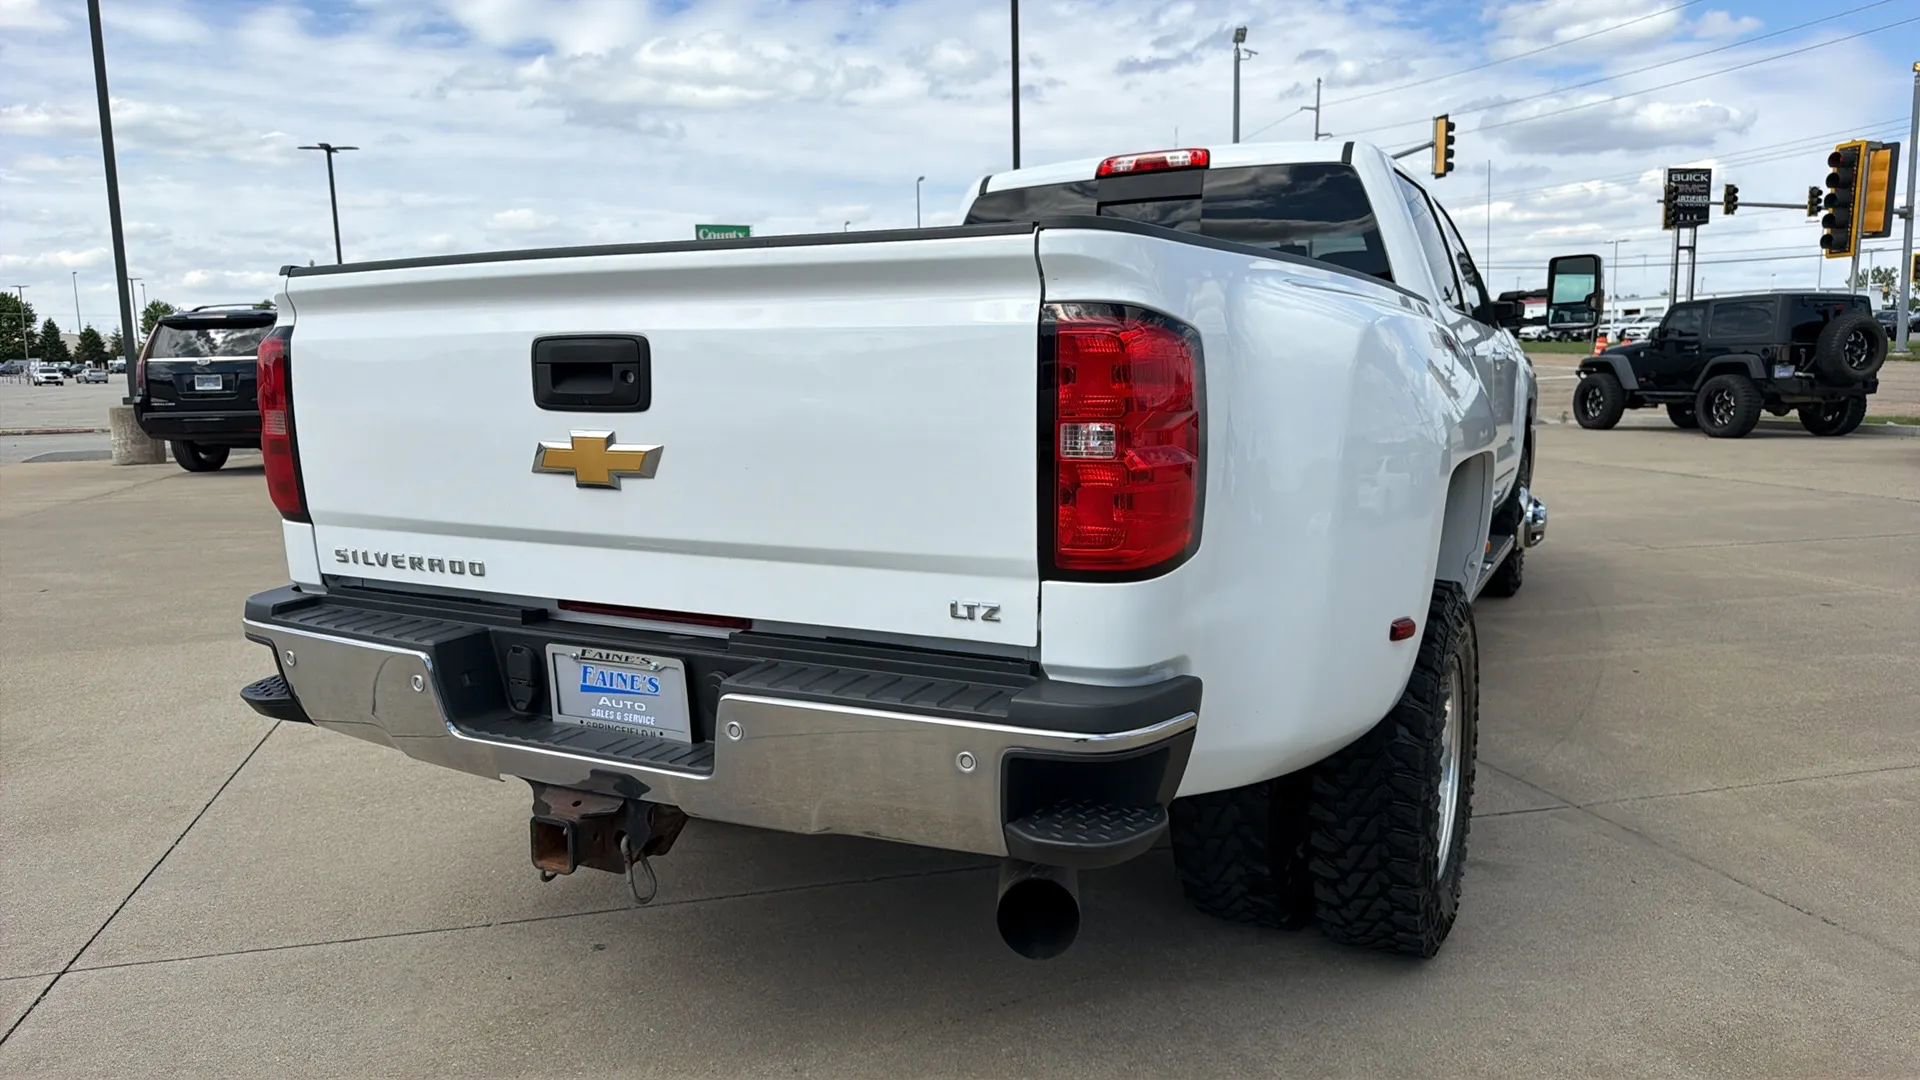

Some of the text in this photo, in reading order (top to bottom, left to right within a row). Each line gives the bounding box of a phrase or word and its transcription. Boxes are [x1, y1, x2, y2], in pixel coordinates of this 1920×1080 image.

[1671, 173, 1709, 182] BUICK
[698, 228, 745, 240] County
[334, 548, 486, 577] SILVERADO
[949, 600, 1002, 622] LTZ
[580, 649, 652, 665] FAINE'S
[581, 665, 660, 693] FAINE'S
[598, 697, 646, 711] AUTO
[591, 708, 656, 725] SALES & SERVICE
